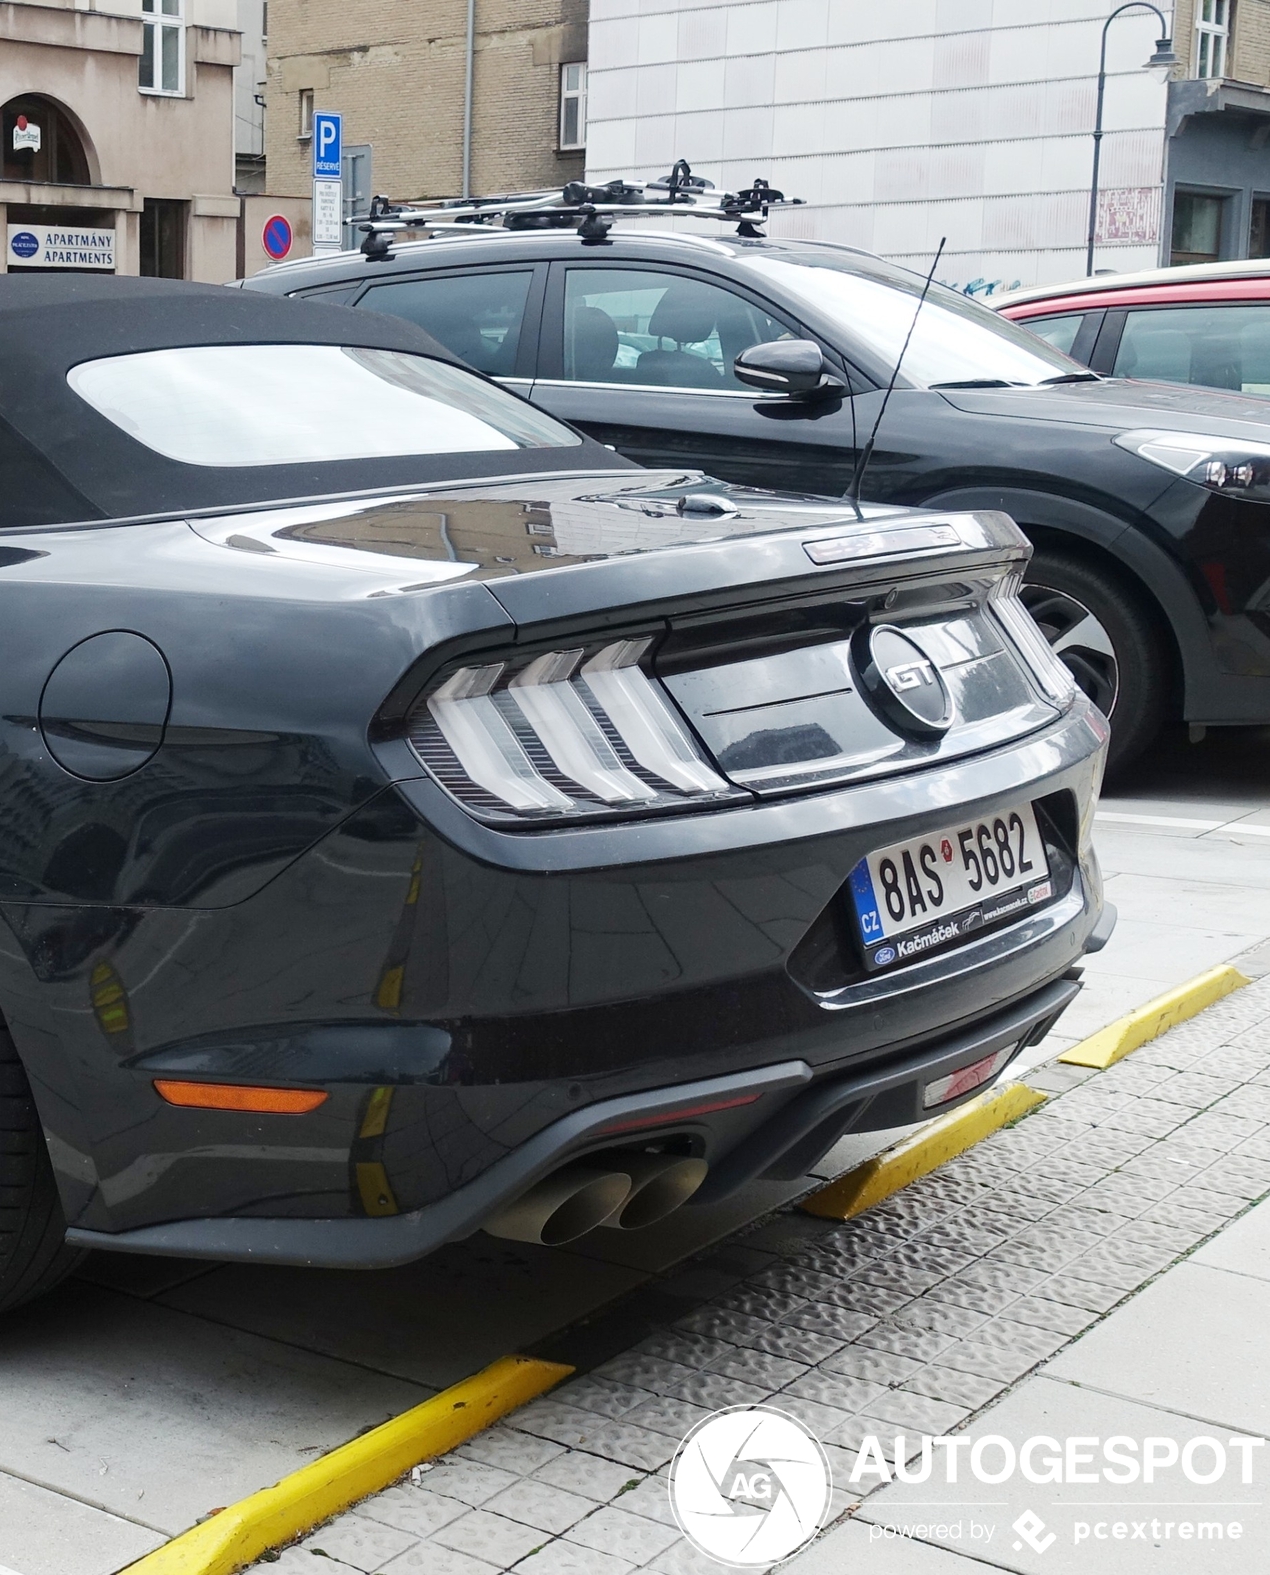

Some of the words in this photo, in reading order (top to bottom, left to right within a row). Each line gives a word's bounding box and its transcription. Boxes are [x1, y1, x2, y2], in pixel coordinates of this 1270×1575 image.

[320, 121, 336, 158] P
[316, 160, 340, 171] RÉSERVÉ
[45, 232, 112, 247] APARTMÁNY
[44, 251, 113, 264] APARTMENTS
[885, 660, 933, 693] GT
[880, 844, 945, 922] 8AS
[957, 811, 1034, 892] 5682
[861, 910, 880, 934] CZ
[896, 921, 960, 958] Kačmáček
[983, 896, 1029, 921] www.kacmacek.cz
